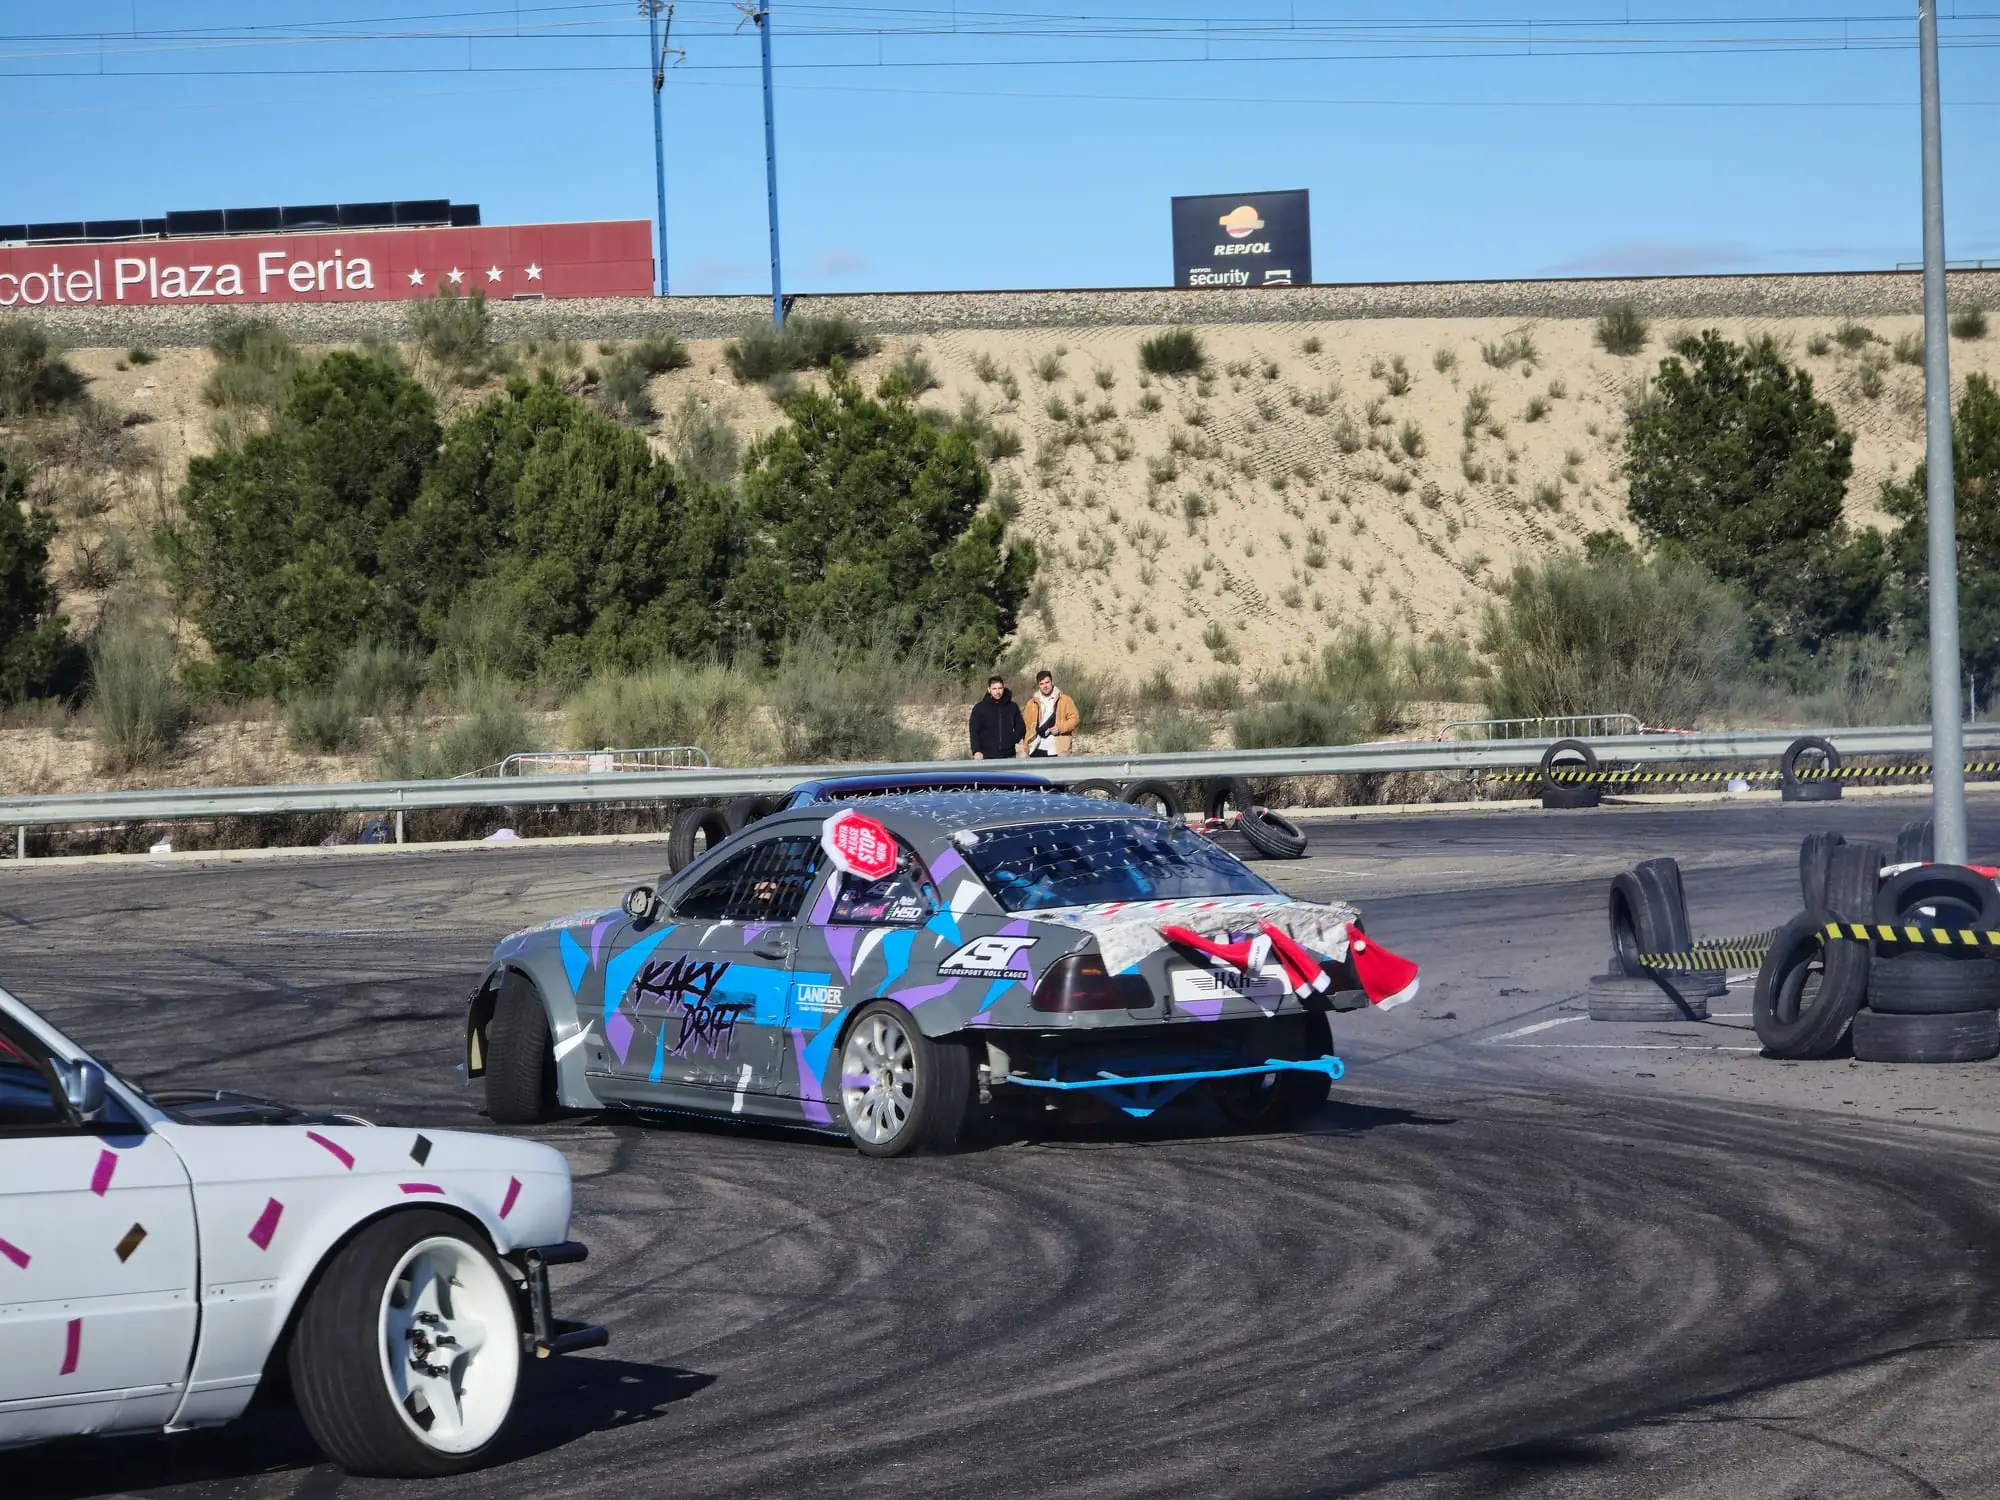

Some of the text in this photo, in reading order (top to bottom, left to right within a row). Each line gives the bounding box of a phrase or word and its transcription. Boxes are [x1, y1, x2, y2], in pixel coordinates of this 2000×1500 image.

[1213, 242, 1272, 256] REPSOL
[114, 257, 244, 301] Plaza
[258, 249, 375, 294] Feria
[1189, 269, 1250, 286] security
[838, 825, 849, 849] SANTA
[847, 826, 859, 856] PLEASE
[857, 827, 876, 865] STOP
[875, 841, 887, 862] HERE
[892, 906, 922, 919] HSD
[939, 936, 1040, 969] AST
[632, 952, 733, 1010] KAKY
[938, 967, 1028, 979] MOTORSPORT ROLL CAGES
[798, 986, 842, 1004] LANDER
[671, 1002, 756, 1060] DRIFT
